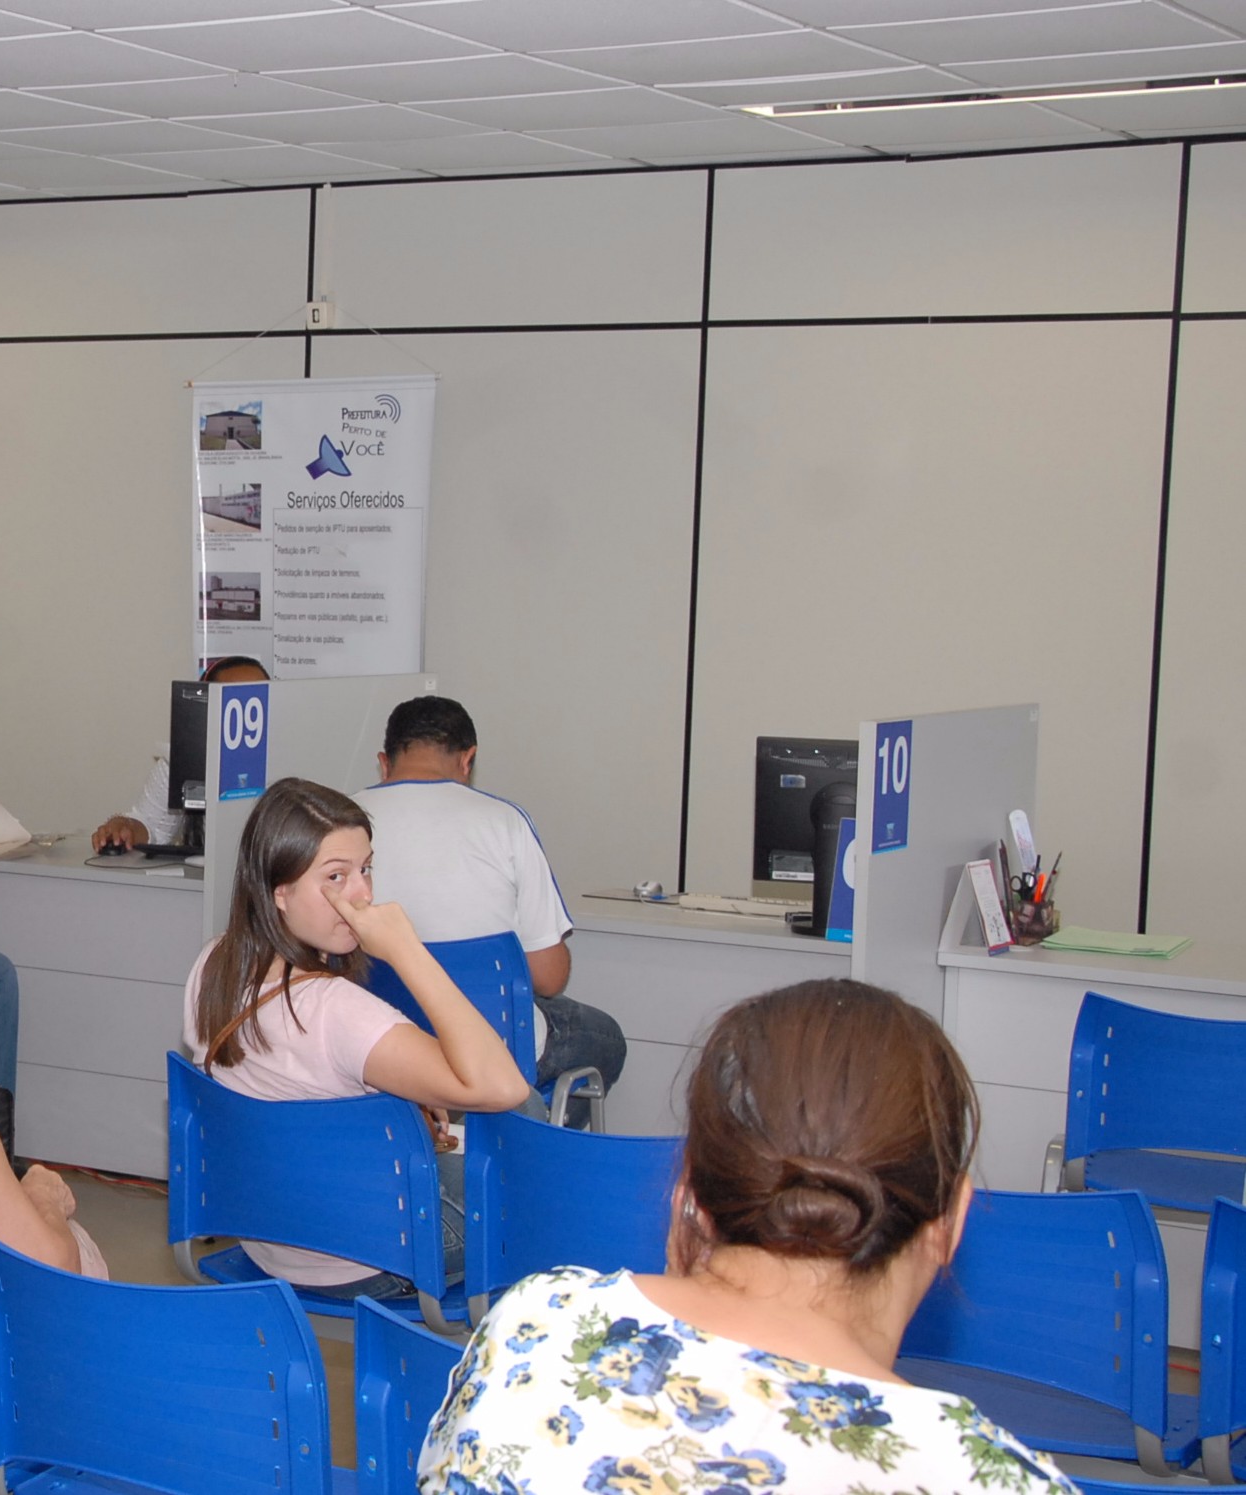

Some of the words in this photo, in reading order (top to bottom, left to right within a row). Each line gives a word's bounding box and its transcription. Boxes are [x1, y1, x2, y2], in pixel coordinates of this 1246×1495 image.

[341, 407, 388, 420] PREFEITURA
[341, 422, 372, 436] PERTO
[375, 430, 387, 438] DE
[340, 440, 385, 456] VOCÊ
[287, 491, 336, 512] Serviços
[340, 490, 405, 509] Oferecidos
[223, 697, 263, 750] 09
[878, 736, 908, 795] 10
